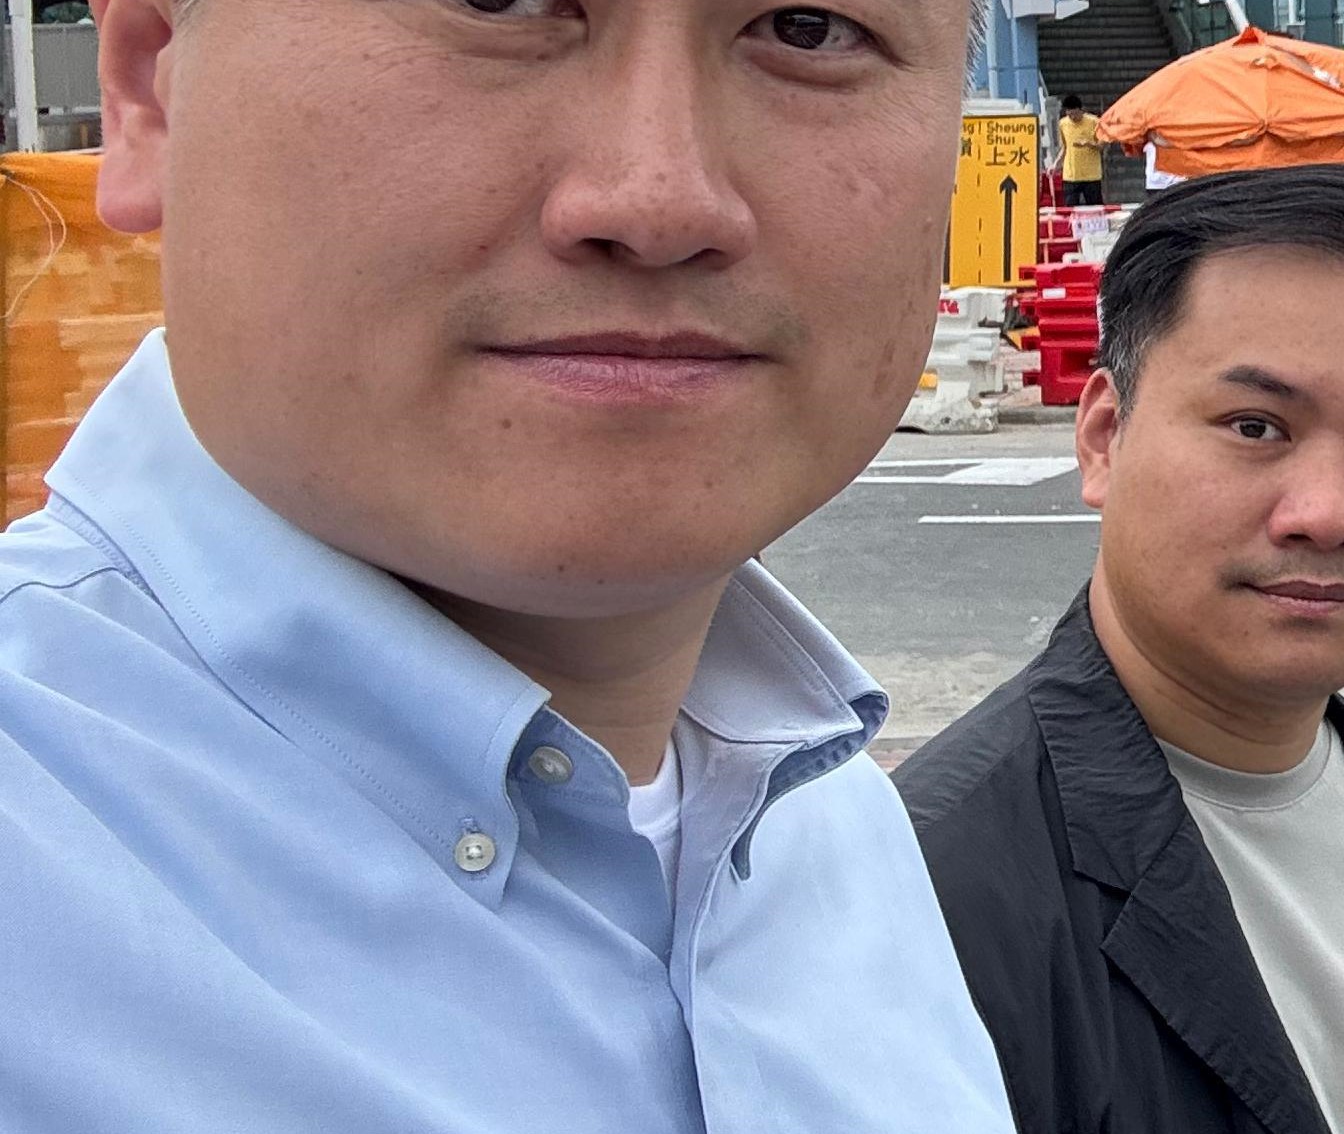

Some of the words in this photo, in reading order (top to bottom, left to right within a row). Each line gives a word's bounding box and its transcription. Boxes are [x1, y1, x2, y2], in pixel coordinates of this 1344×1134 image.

[986, 121, 1035, 135] Sheung
[986, 134, 1016, 145] Shui
[985, 146, 1030, 167] 上水
